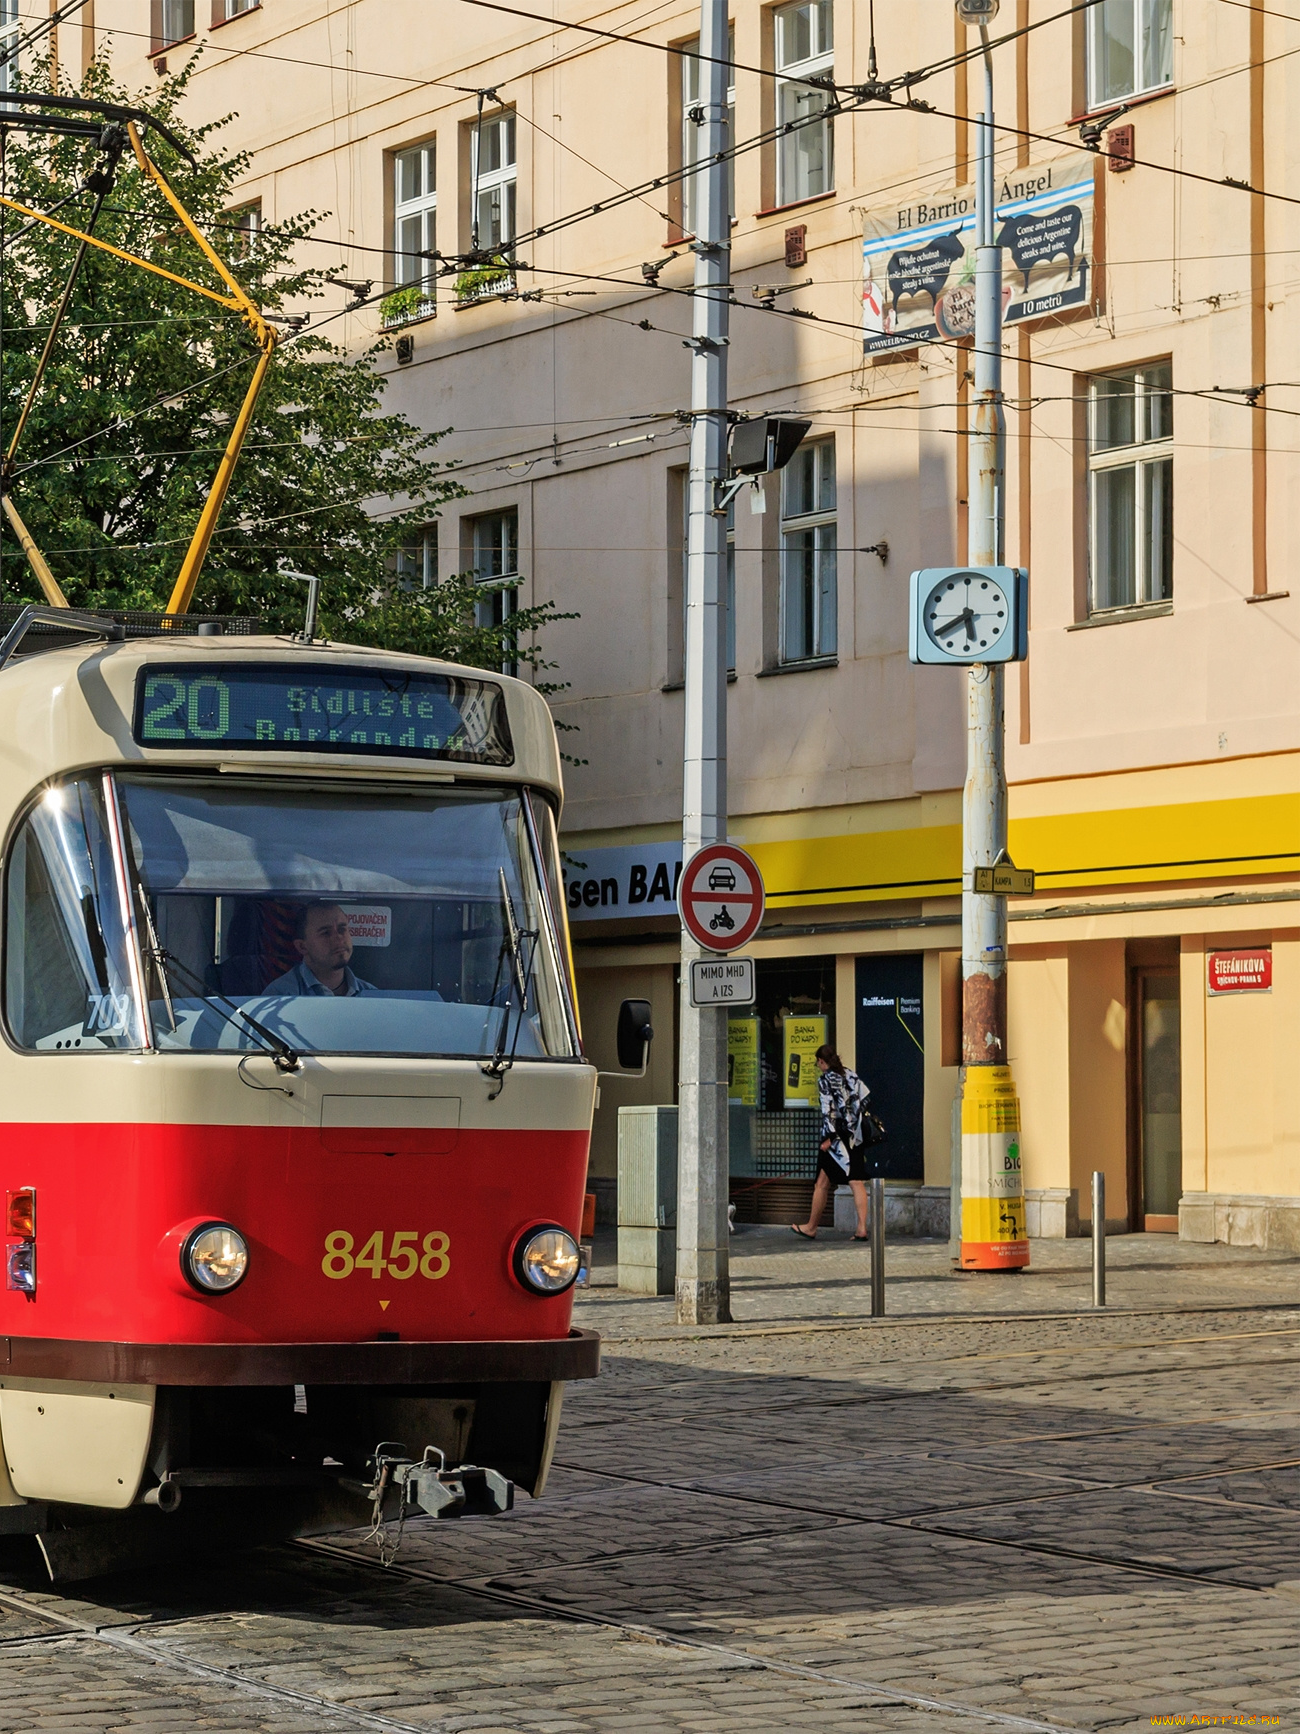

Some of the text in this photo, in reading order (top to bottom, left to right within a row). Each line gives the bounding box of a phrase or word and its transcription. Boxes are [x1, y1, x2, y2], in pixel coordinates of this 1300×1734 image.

[897, 196, 968, 230] El Barrio
[1016, 213, 1073, 236] Come and taste our
[1017, 227, 1071, 248] delicious Argentine
[1021, 246, 1039, 260] steaks
[1039, 244, 1051, 253] and
[951, 291, 962, 303] El
[1022, 301, 1034, 315] 10
[143, 674, 230, 740] 20
[287, 686, 435, 719] Sídliště
[346, 912, 388, 925] POJOVAČEM
[700, 965, 745, 979] MIMO MHD
[1214, 956, 1265, 975] ŠTEFÁNIKOVA
[712, 984, 734, 998] A IZS
[794, 1026, 816, 1034] BANKA
[801, 1035, 820, 1043] KAPSY
[321, 1229, 451, 1280] 8458
